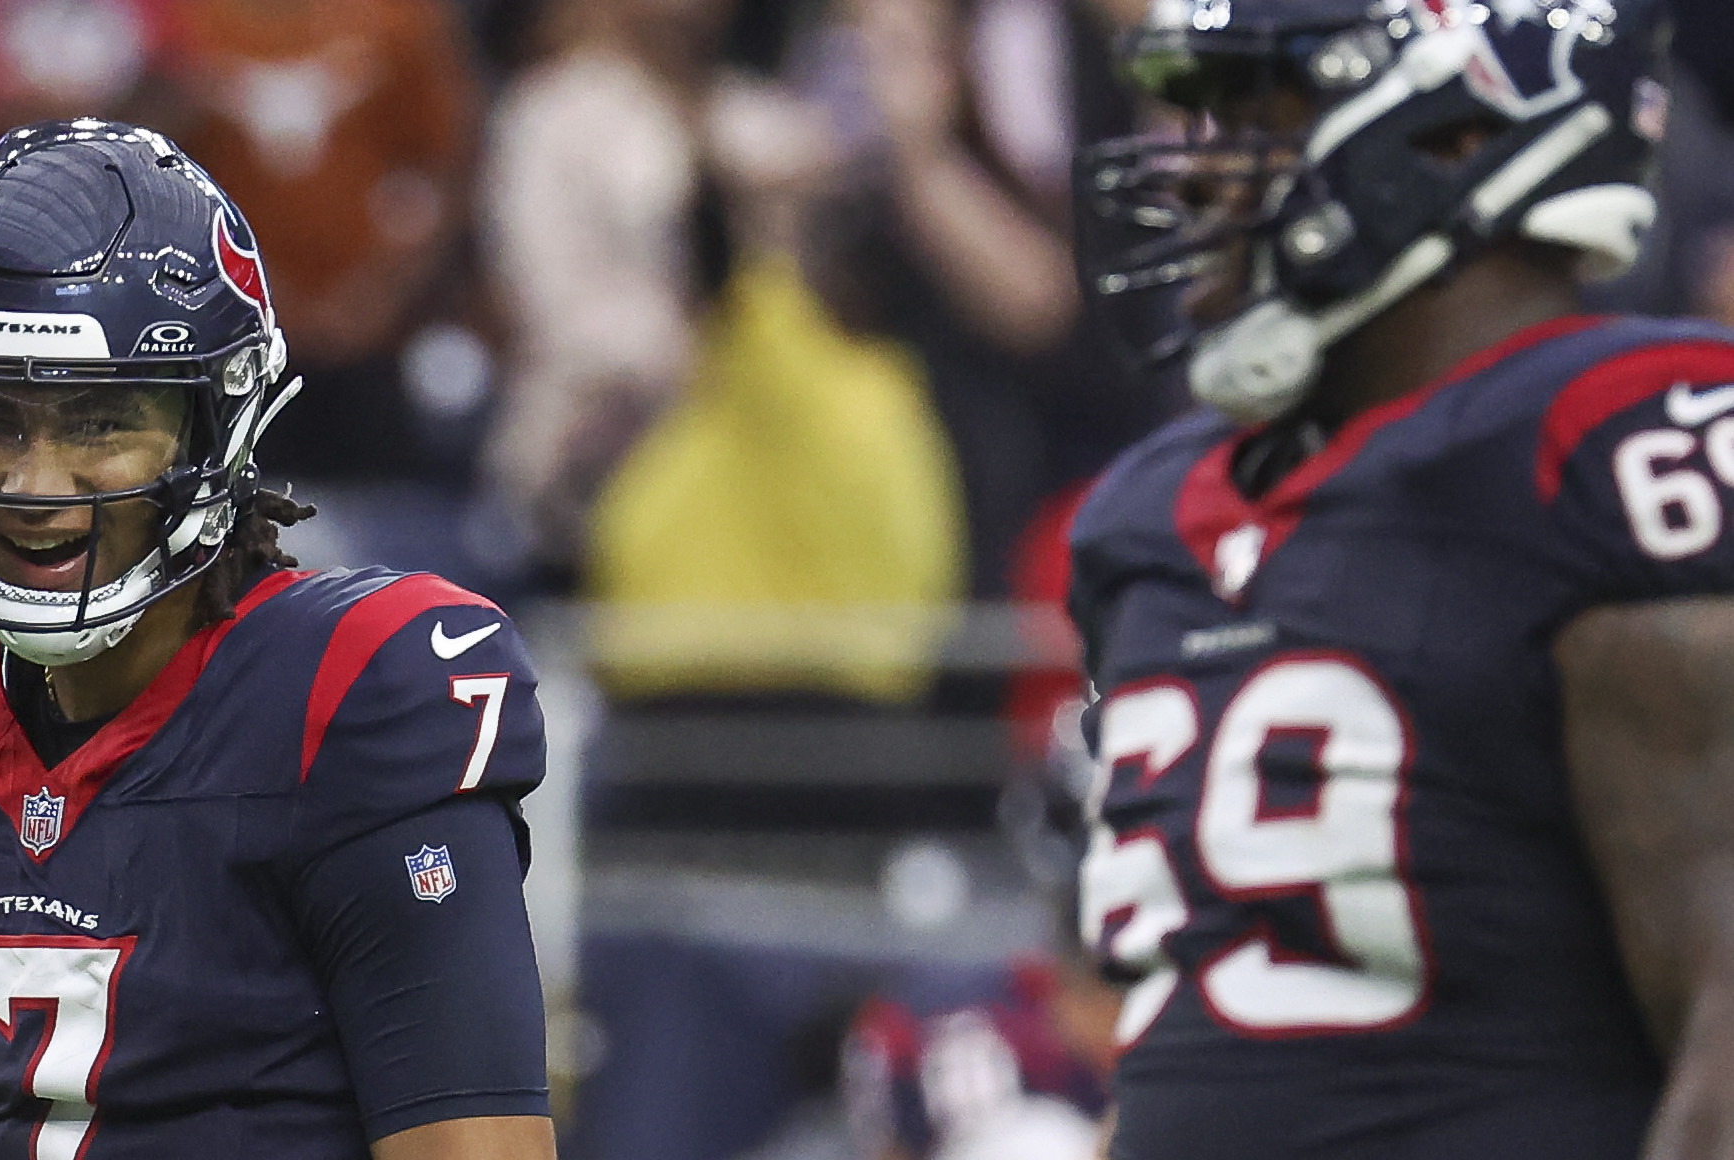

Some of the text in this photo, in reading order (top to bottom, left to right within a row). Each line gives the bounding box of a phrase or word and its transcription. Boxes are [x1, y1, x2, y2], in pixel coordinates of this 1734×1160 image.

[140, 342, 196, 352] OAKLEY
[1612, 417, 1734, 562] 6
[449, 672, 511, 794] 7
[26, 817, 54, 843] NFL
[1079, 648, 1432, 1053] 69
[416, 867, 452, 894] NFL
